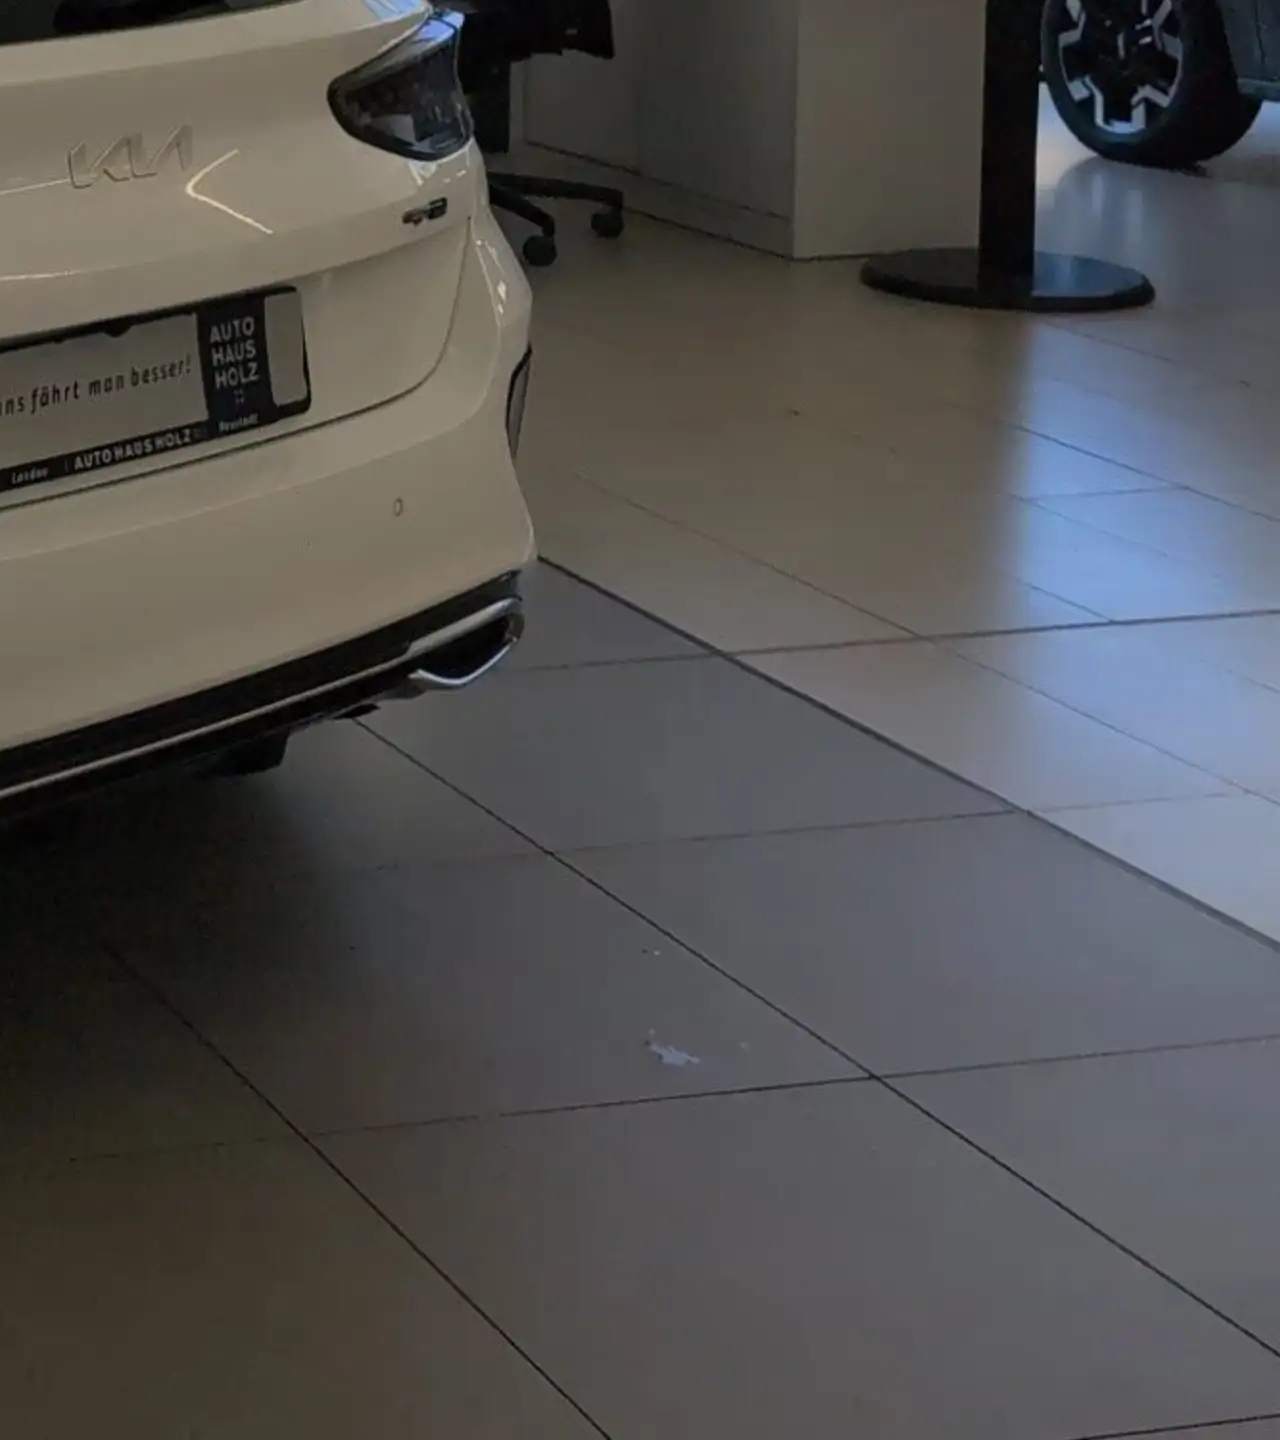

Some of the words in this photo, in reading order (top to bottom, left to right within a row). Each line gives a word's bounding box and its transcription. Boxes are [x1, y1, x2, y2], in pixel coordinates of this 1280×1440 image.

[67, 124, 193, 189] KIA
[209, 316, 255, 343] AUTO
[211, 339, 257, 367] HAUS
[29, 380, 80, 415] fährt
[88, 373, 125, 397] man
[130, 353, 192, 388] besser!
[214, 362, 260, 389] HOLZ
[154, 428, 192, 452] HOLZ
